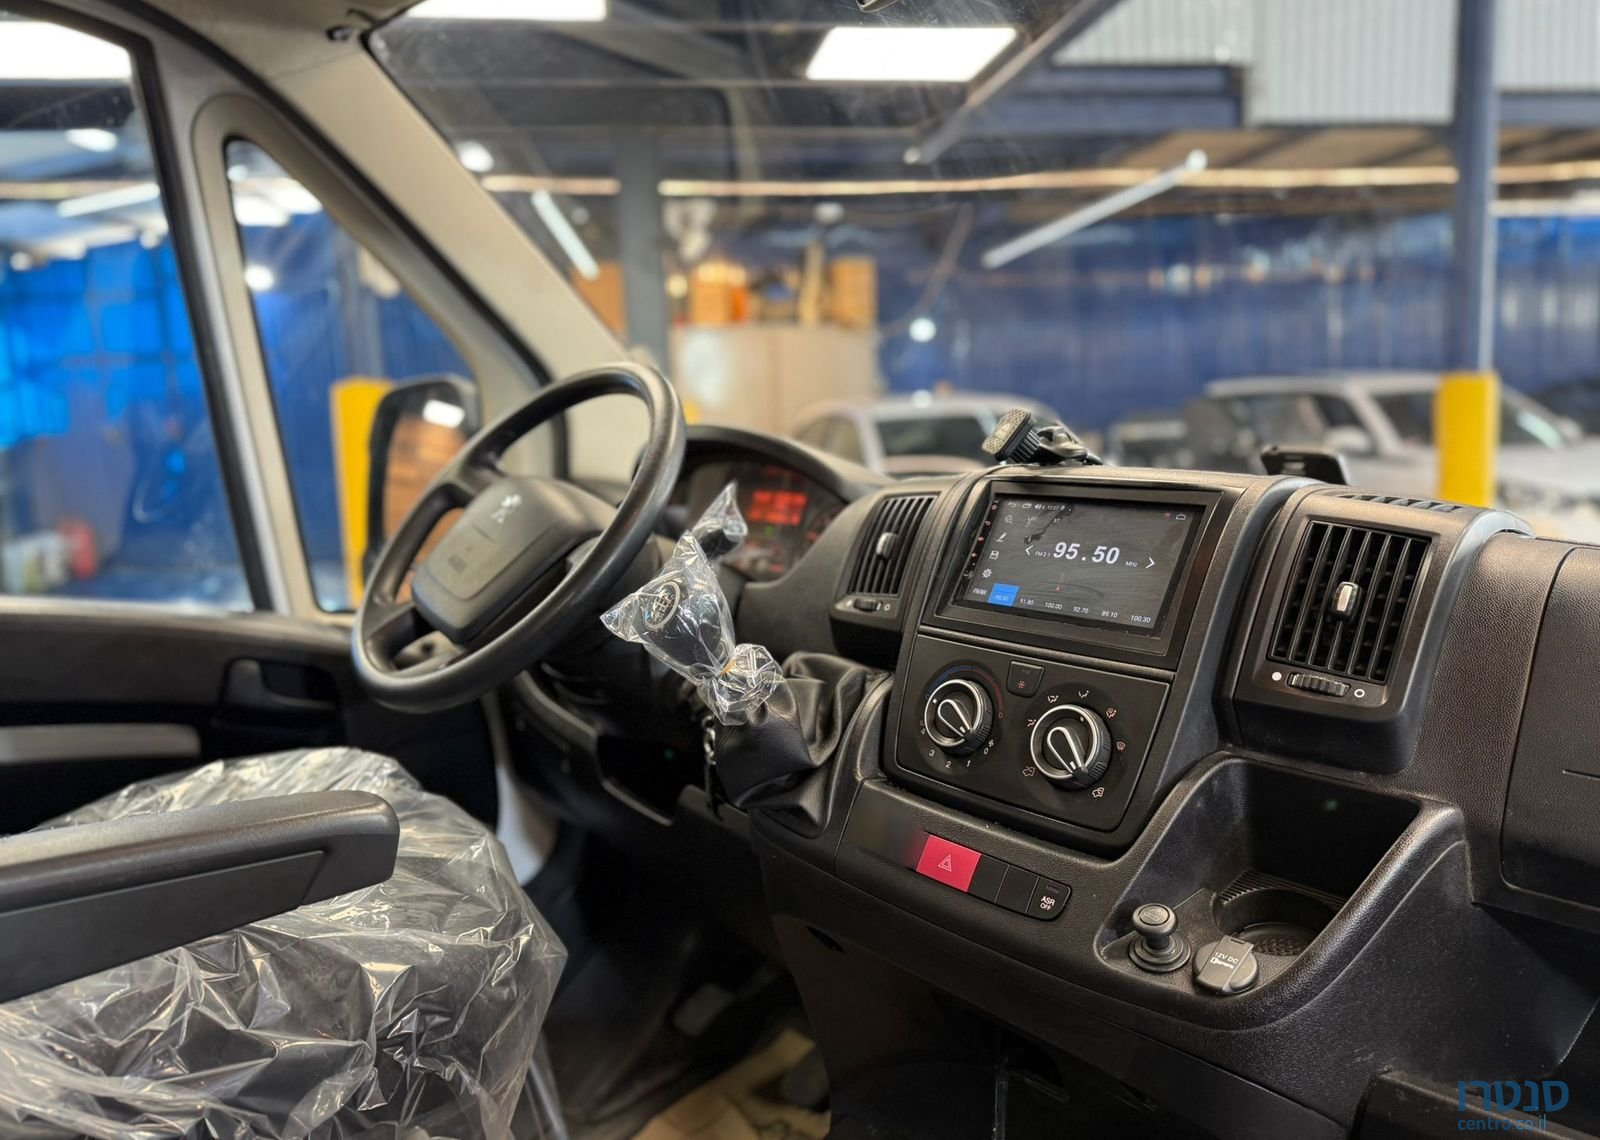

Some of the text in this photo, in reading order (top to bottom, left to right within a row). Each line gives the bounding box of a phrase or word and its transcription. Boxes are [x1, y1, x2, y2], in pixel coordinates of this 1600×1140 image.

[1053, 541, 1120, 564] 95.50
[1045, 602, 1063, 610] 100.00
[1073, 606, 1089, 614] 92.70
[1101, 610, 1119, 618] 89.10
[1131, 614, 1152, 623] 100.30
[928, 749, 936, 757] 3
[945, 760, 952, 768] 2
[1040, 895, 1056, 906] ASR
[1040, 902, 1052, 911] OFF
